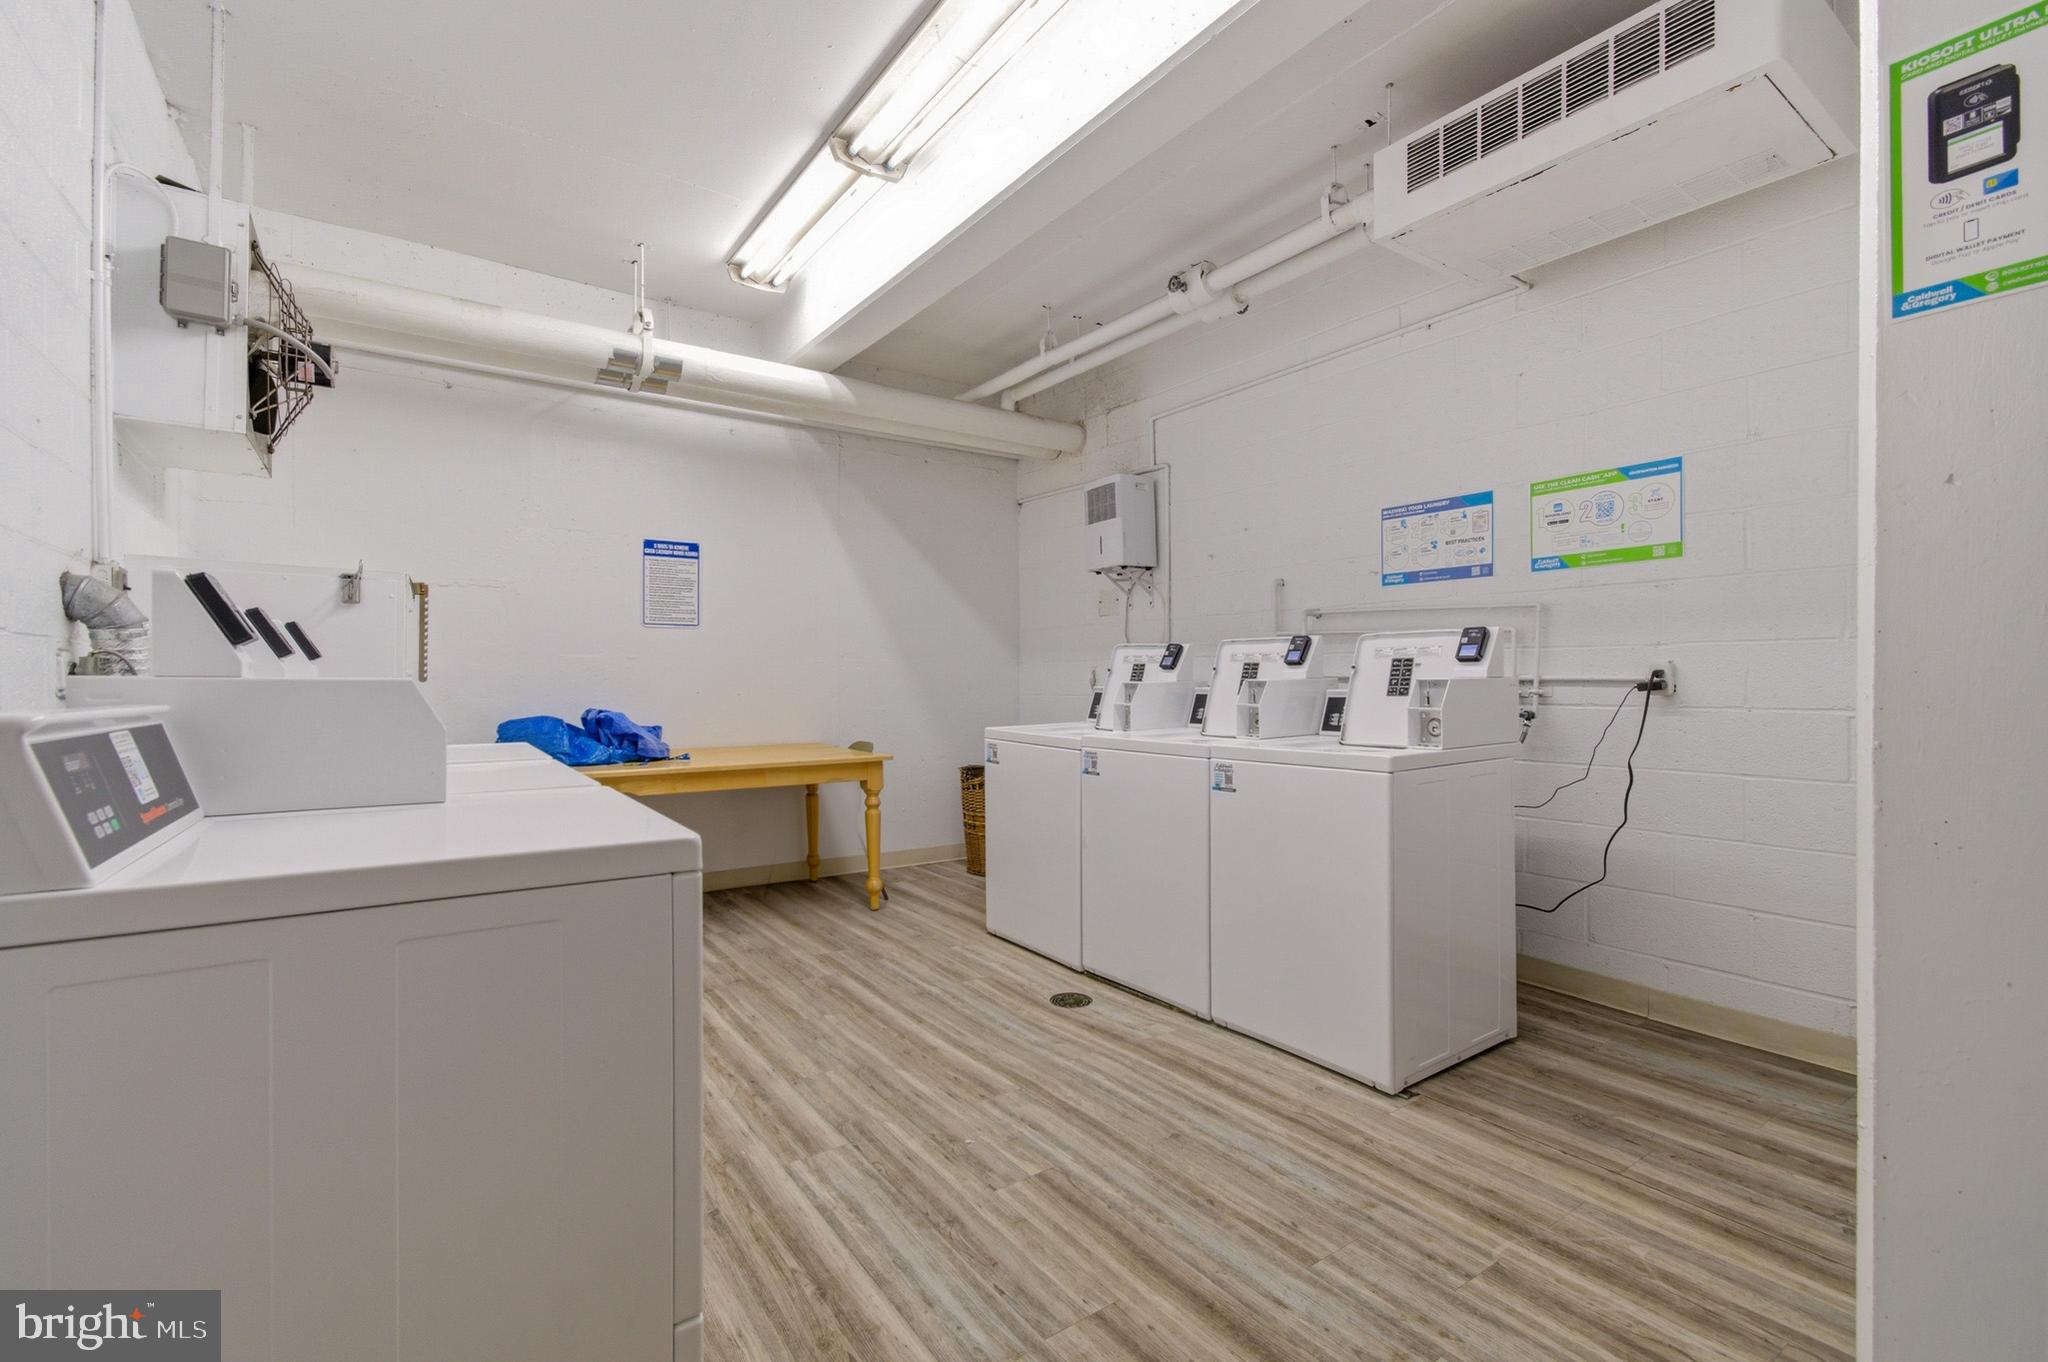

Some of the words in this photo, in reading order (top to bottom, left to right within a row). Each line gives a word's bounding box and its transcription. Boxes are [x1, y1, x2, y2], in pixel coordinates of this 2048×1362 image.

[1901, 35, 1976, 73] KIOSOFT
[1980, 10, 2040, 41] ULTRA
[1933, 207, 1959, 219] CREDIT
[1988, 190, 2017, 203] CARDS
[1926, 250, 1954, 262] DIGITAL
[1956, 240, 1986, 253] WALLET
[1987, 229, 2025, 243] PAYMENT
[1907, 285, 1953, 304] Caldwell
